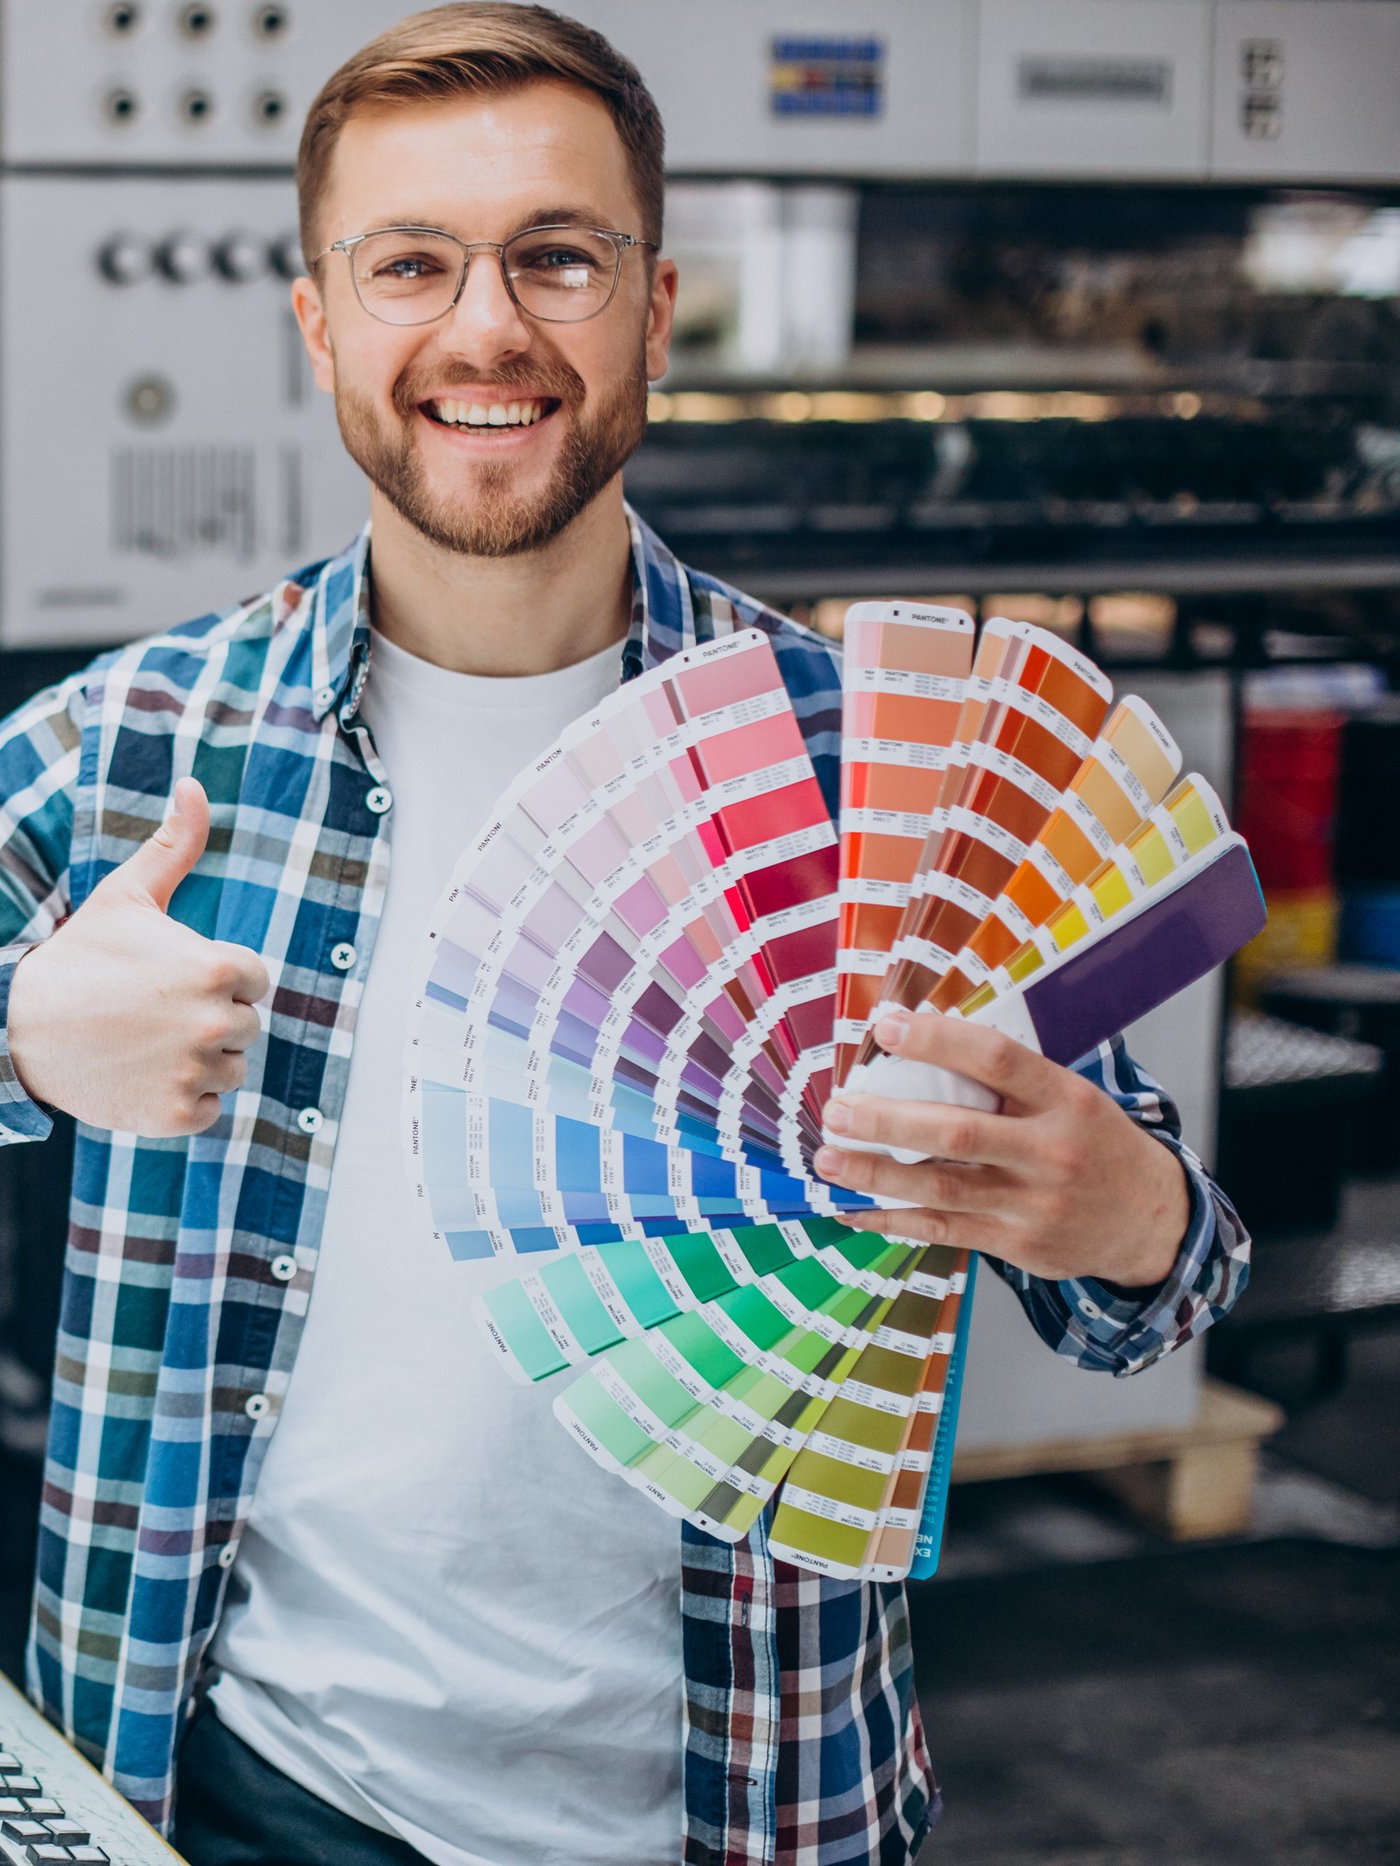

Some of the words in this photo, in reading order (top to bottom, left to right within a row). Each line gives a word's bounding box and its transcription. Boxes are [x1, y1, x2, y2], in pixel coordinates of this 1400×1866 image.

[911, 613, 947, 625] PANTONE
[703, 641, 739, 658] PANTONE
[885, 670, 909, 678] PANTONE
[1074, 661, 1098, 684] PANTONE
[879, 740, 904, 748] PANTONE
[1149, 720, 1170, 748] PANTONE
[557, 812, 579, 831] PANTONE
[873, 810, 898, 818] PANTONE
[603, 866, 625, 884] PANTONE
[510, 884, 528, 905] PANTONE
[564, 927, 582, 948] PANTONE
[649, 919, 670, 937] PANTONE
[487, 929, 503, 951] PANTONE
[546, 965, 562, 987] PANTONE
[619, 970, 637, 992] PANTONE
[463, 1024, 474, 1048] PANTONE
[462, 1057, 472, 1082] PANTONE
[412, 1119, 420, 1155] PANTONE
[539, 1190, 547, 1214] PANTONE
[488, 1230, 499, 1251] PANTONE
[782, 1226, 797, 1248] PANTONE
[723, 1253, 738, 1274] PANTONE
[820, 1259, 839, 1279] PANTONE
[664, 1278, 680, 1300] PANTONE
[912, 1286, 936, 1296] PANTONE
[607, 1304, 622, 1325] PANTONE
[772, 1299, 792, 1319] PANTONE
[487, 1321, 508, 1353] PANTONE
[550, 1329, 566, 1350] PANTONE
[725, 1339, 744, 1358] PANTONE
[893, 1344, 918, 1355] PANTONE
[769, 1368, 791, 1385] PANTONE
[679, 1378, 697, 1397] PANTONE
[876, 1403, 900, 1414] PANTONE
[632, 1415, 651, 1435] PANTONE
[731, 1414, 752, 1431] PANTONE
[573, 1423, 599, 1452] PANTONE
[693, 1459, 714, 1477] PANTONE
[858, 1460, 882, 1471] PANTONE
[840, 1517, 864, 1528] PANTONE
[794, 1553, 829, 1569] PANTONE
